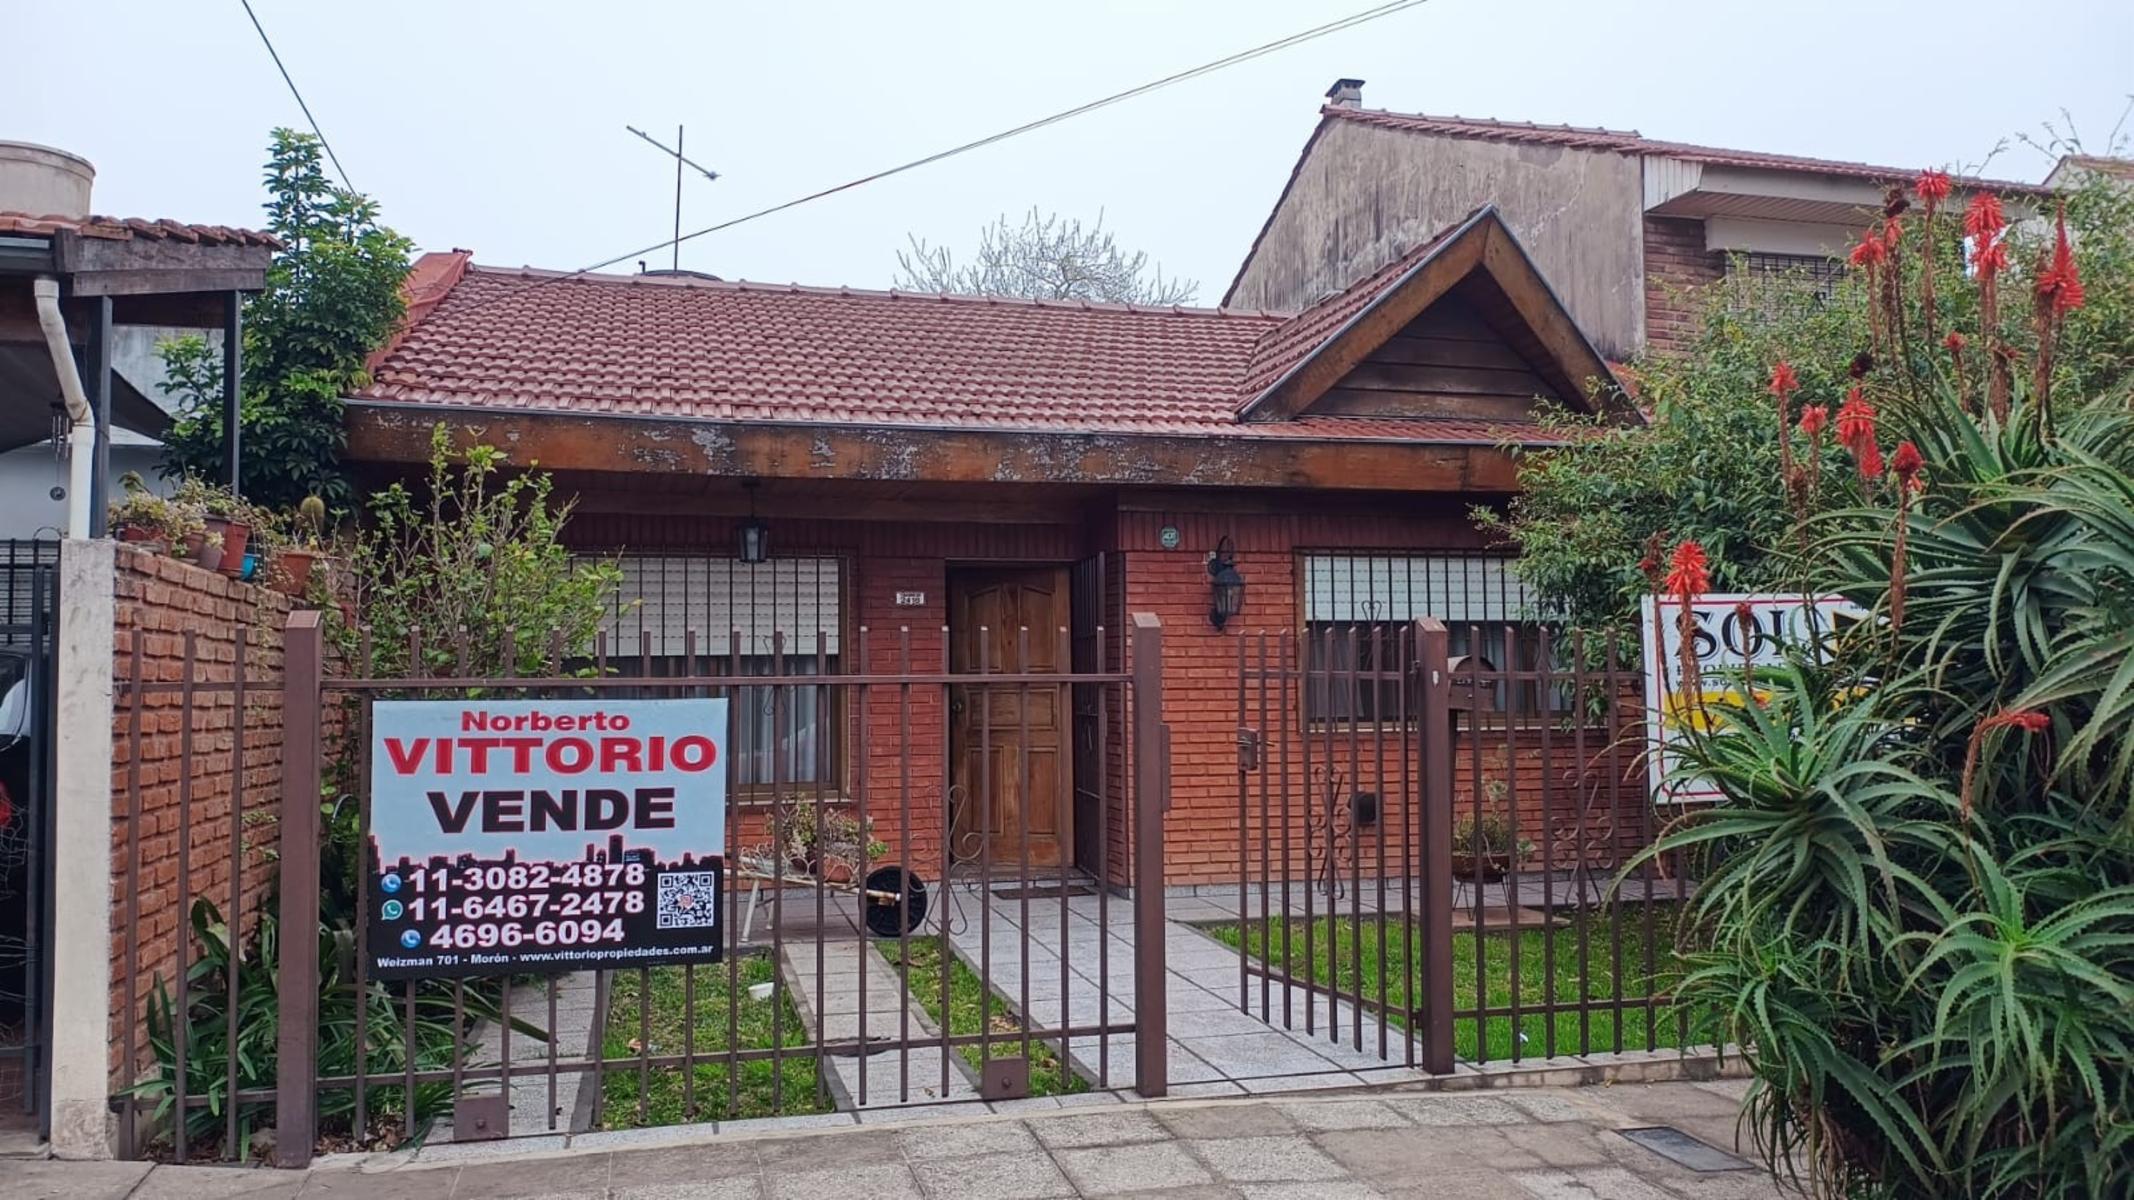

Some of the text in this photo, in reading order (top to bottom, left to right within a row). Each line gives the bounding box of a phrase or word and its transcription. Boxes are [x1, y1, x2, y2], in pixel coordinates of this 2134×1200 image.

[461, 710, 630, 731] Norberto
[384, 735, 717, 774] VITTORIO
[426, 787, 675, 834] VENDE
[408, 864, 645, 893] 11-3082-4878
[408, 891, 645, 921] 11-6467-2478
[429, 918, 625, 949] 4696-6094
[377, 957, 433, 968] Weizman
[437, 955, 459, 965] 701
[471, 953, 509, 964] Morón
[520, 945, 713, 962] www.vittoriopropiedades.com.ar
